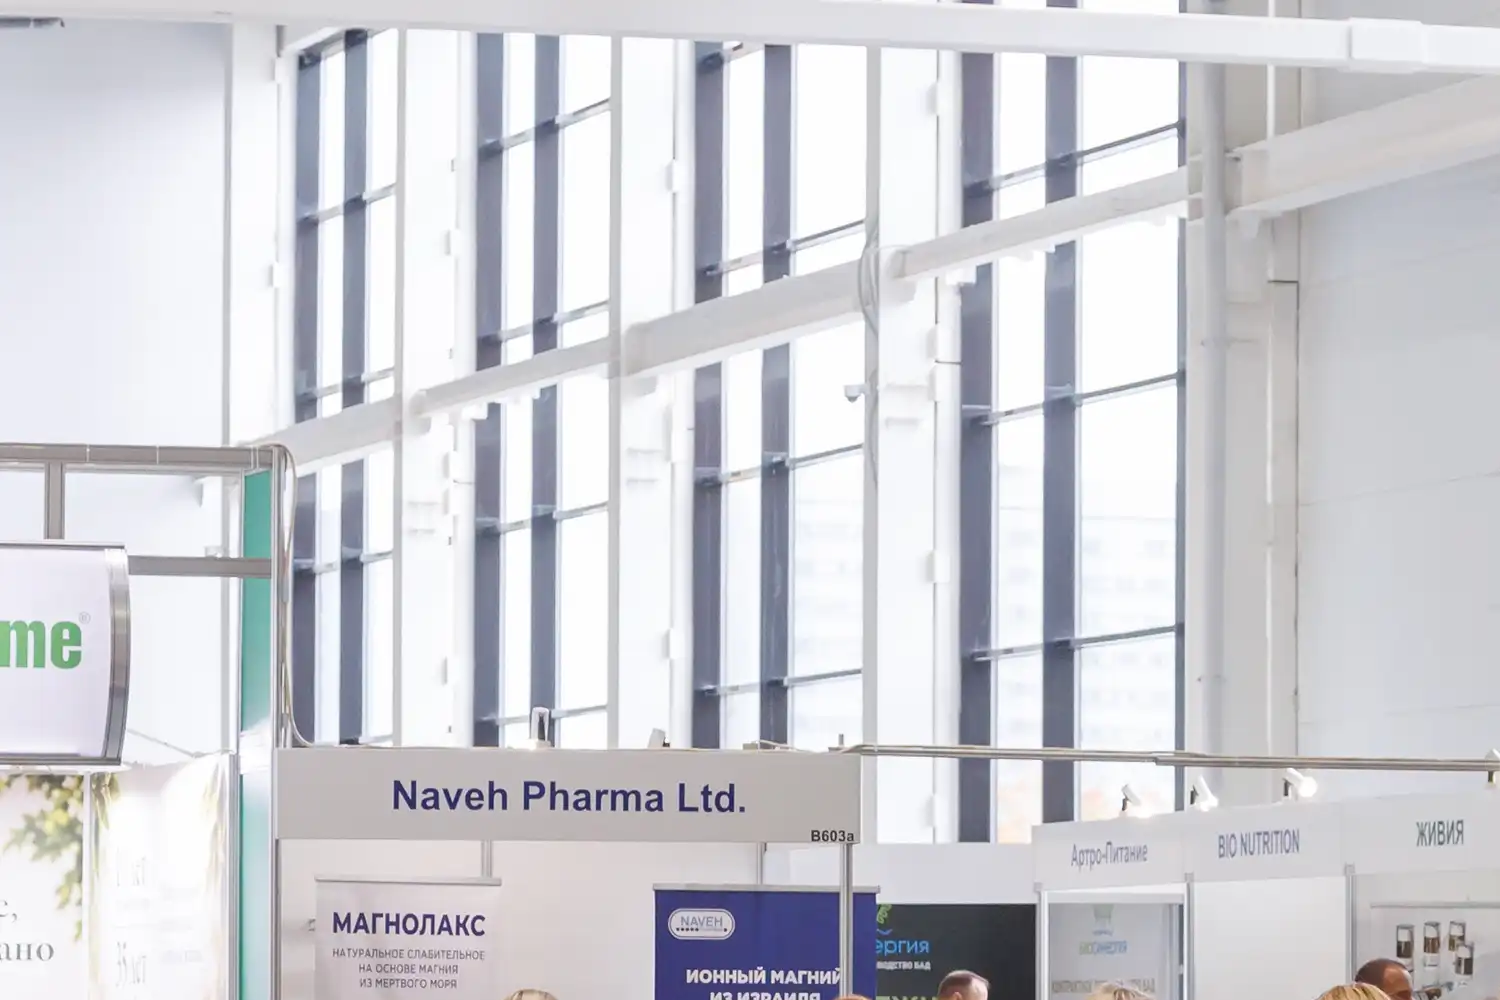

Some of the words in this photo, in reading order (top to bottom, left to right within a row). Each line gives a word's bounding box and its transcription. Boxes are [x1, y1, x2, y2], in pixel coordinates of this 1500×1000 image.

[392, 780, 508, 811] Naveh
[523, 781, 664, 812] Pharma
[679, 782, 746, 813] Ltd.
[810, 830, 855, 842] B603a
[1416, 819, 1465, 847] ЖИВИЯ
[1218, 833, 1238, 858] BIO
[1240, 828, 1300, 857] NUTRITION
[1071, 841, 1148, 871] Артро-Питание
[332, 911, 486, 937] МАГНОЛАКС
[680, 916, 723, 927] NAVEH
[332, 948, 405, 959] НАТУРАЛЬНОЕ
[407, 949, 485, 961] СЛАБИТЕЛЬНОЕ
[358, 963, 373, 973] НА
[375, 963, 416, 974] ОСНОВЕ
[418, 964, 459, 974] МАГНИЯ
[686, 966, 766, 985] ИОННЫЙ
[770, 967, 841, 985] МАГНИЙ
[359, 978, 372, 988] ИЗ
[375, 978, 428, 989] МЕРТВОГО
[429, 979, 457, 989] МОРЯ
